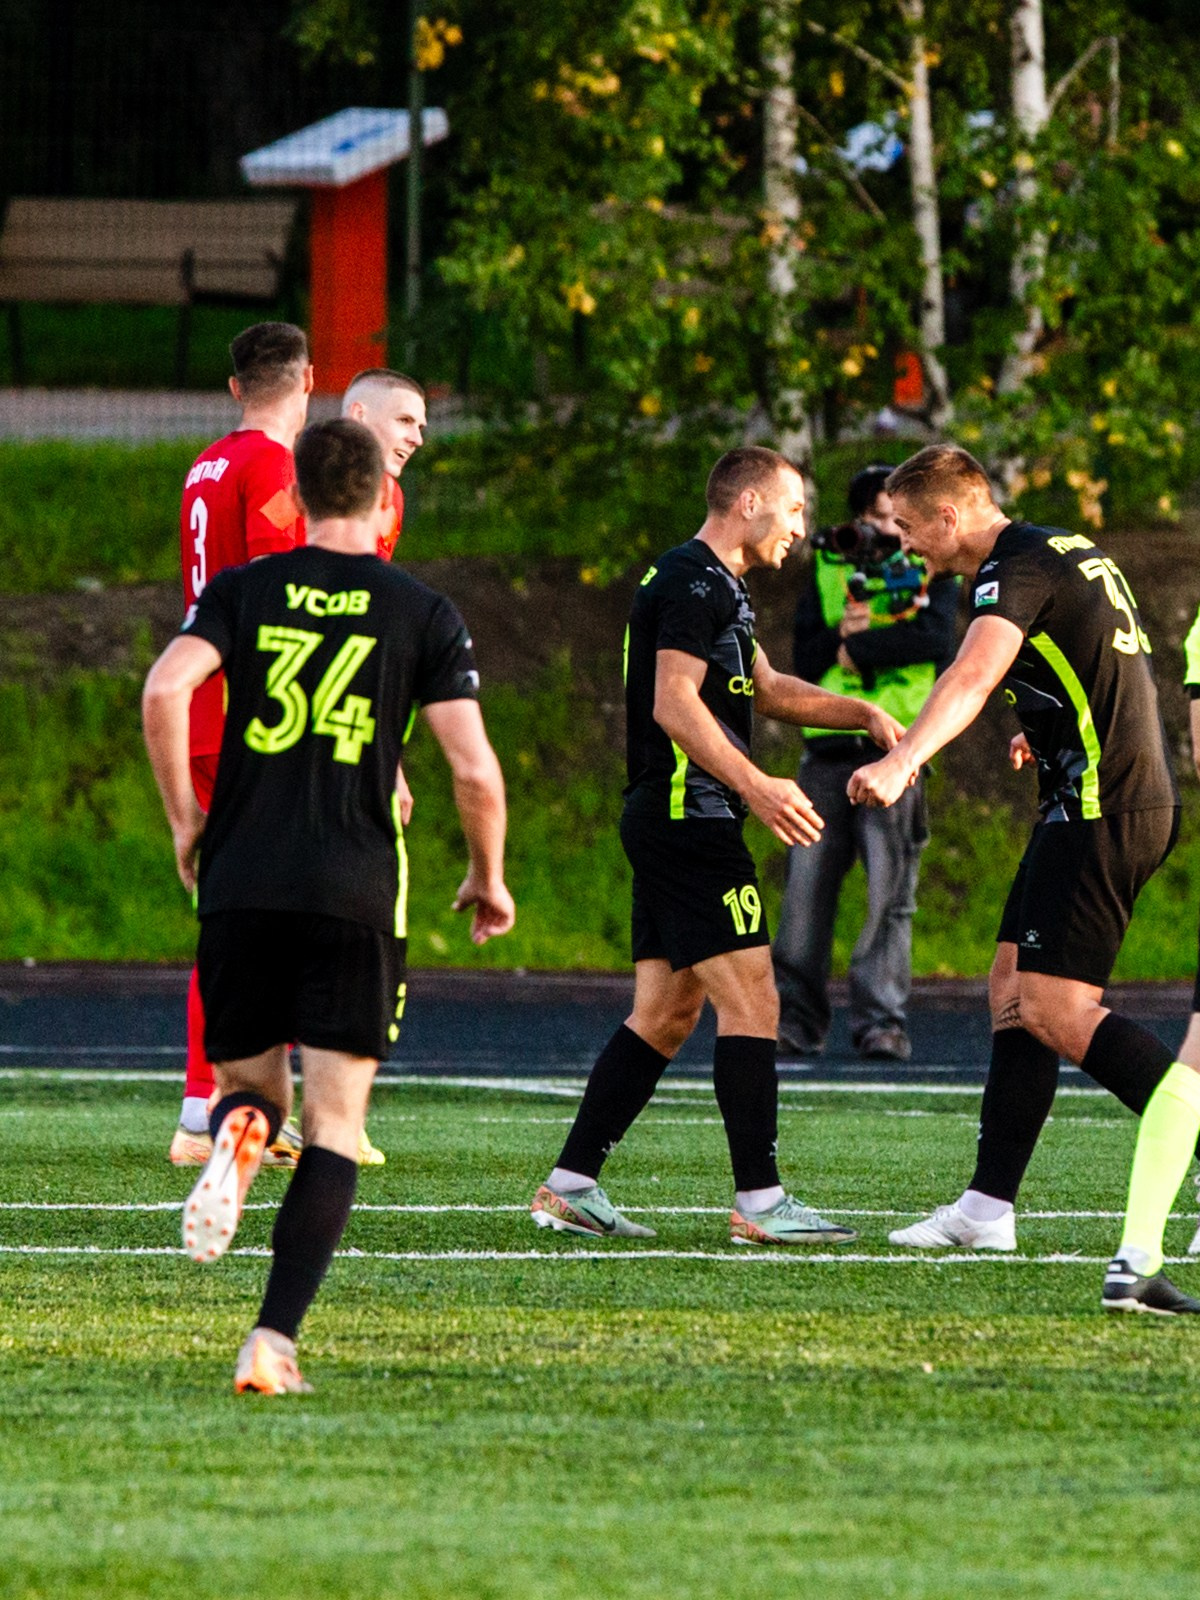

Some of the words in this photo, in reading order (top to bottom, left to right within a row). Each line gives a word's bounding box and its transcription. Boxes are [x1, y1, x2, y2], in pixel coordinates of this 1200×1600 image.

[190, 496, 209, 598] 3
[285, 582, 371, 617] УСОВ
[243, 624, 378, 766] 34
[722, 884, 762, 936] 19
